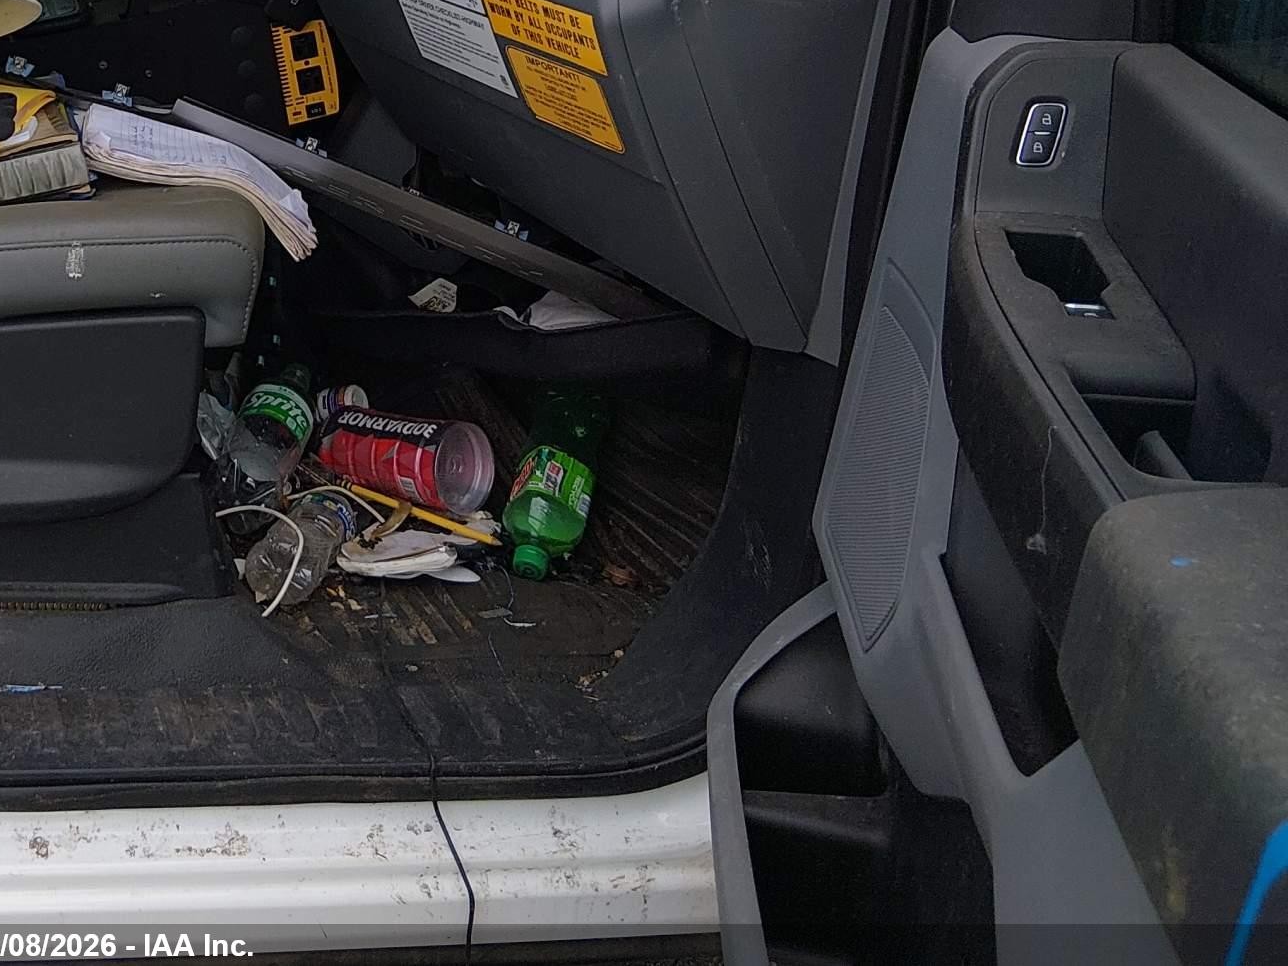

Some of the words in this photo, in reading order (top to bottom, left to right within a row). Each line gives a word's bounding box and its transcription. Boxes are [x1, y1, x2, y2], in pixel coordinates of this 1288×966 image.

[488, 1, 512, 19] WORN
[513, 10, 524, 23] BY
[528, 15, 544, 31] ALL
[545, 21, 596, 51] OCCUPANTS
[541, 5, 566, 24] MUST
[569, 14, 582, 29] BE
[510, 23, 521, 36] OF
[523, 28, 544, 45] THIS
[545, 36, 581, 59] VEHICLE
[525, 56, 581, 83] IMPORTANT!
[246, 393, 308, 432] Sprite
[337, 411, 438, 439] BODYARMOR
